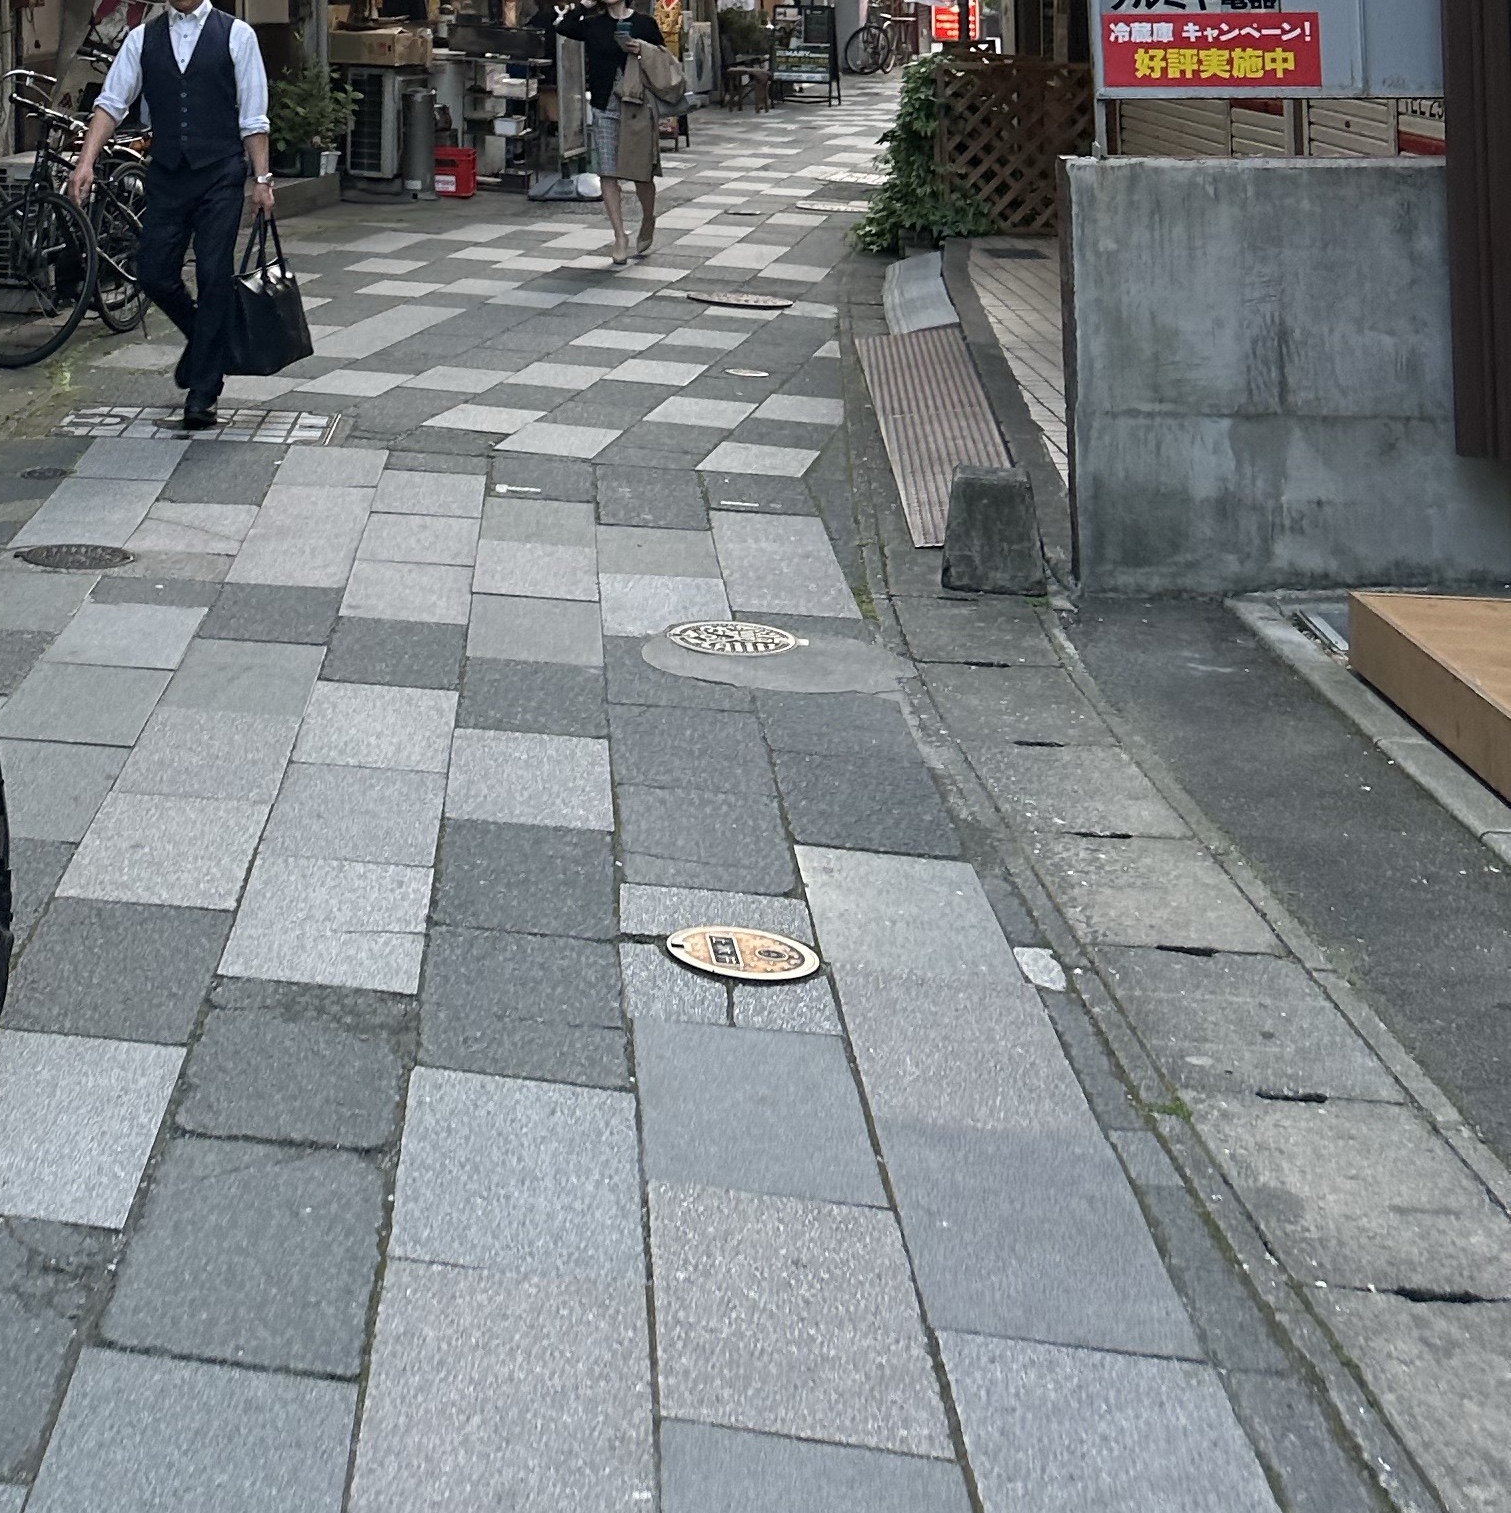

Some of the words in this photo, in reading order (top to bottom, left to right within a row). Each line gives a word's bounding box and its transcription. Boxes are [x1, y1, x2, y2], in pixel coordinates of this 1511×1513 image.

[1109, 22, 1175, 44] 冷蔵庫
[1134, 48, 1296, 79] 好評実施中
